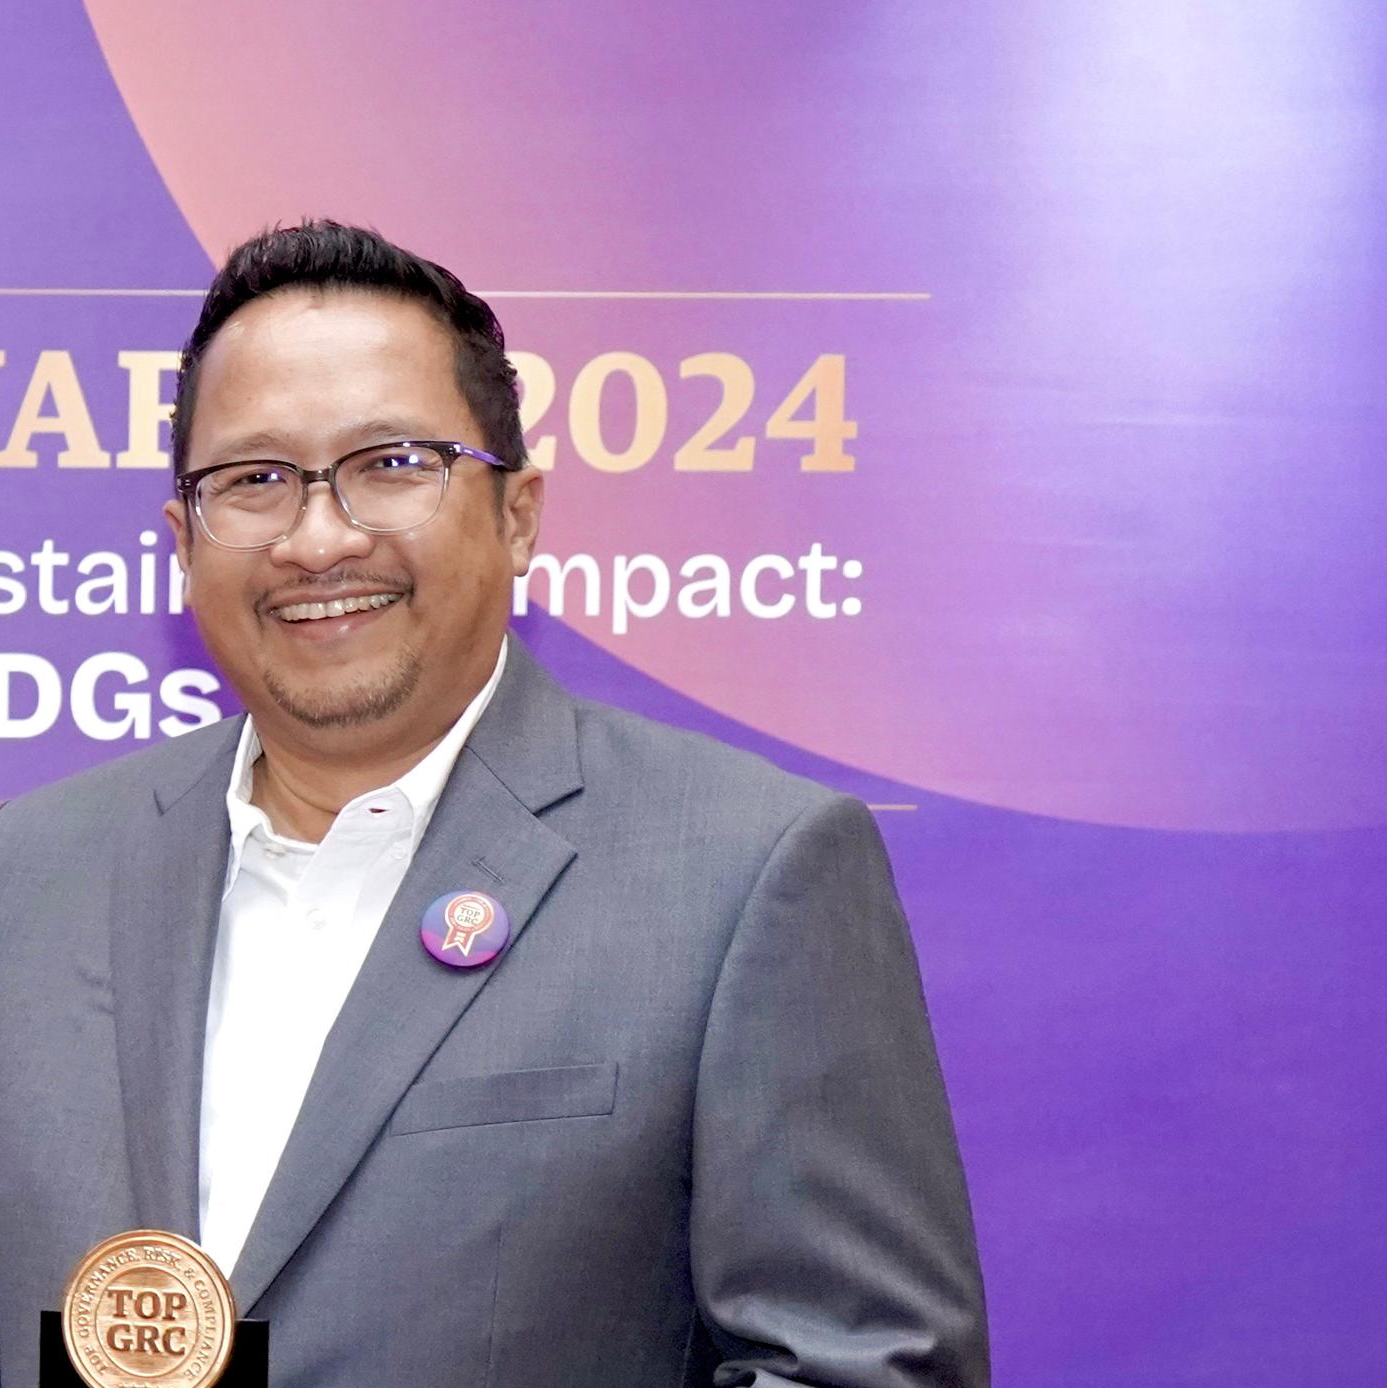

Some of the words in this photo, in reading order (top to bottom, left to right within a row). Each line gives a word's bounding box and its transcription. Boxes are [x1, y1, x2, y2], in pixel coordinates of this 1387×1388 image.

[508, 351, 858, 473] 2024
[513, 542, 863, 635] mpact:
[107, 1289, 187, 1321] TOP
[107, 1323, 185, 1356] GRC
